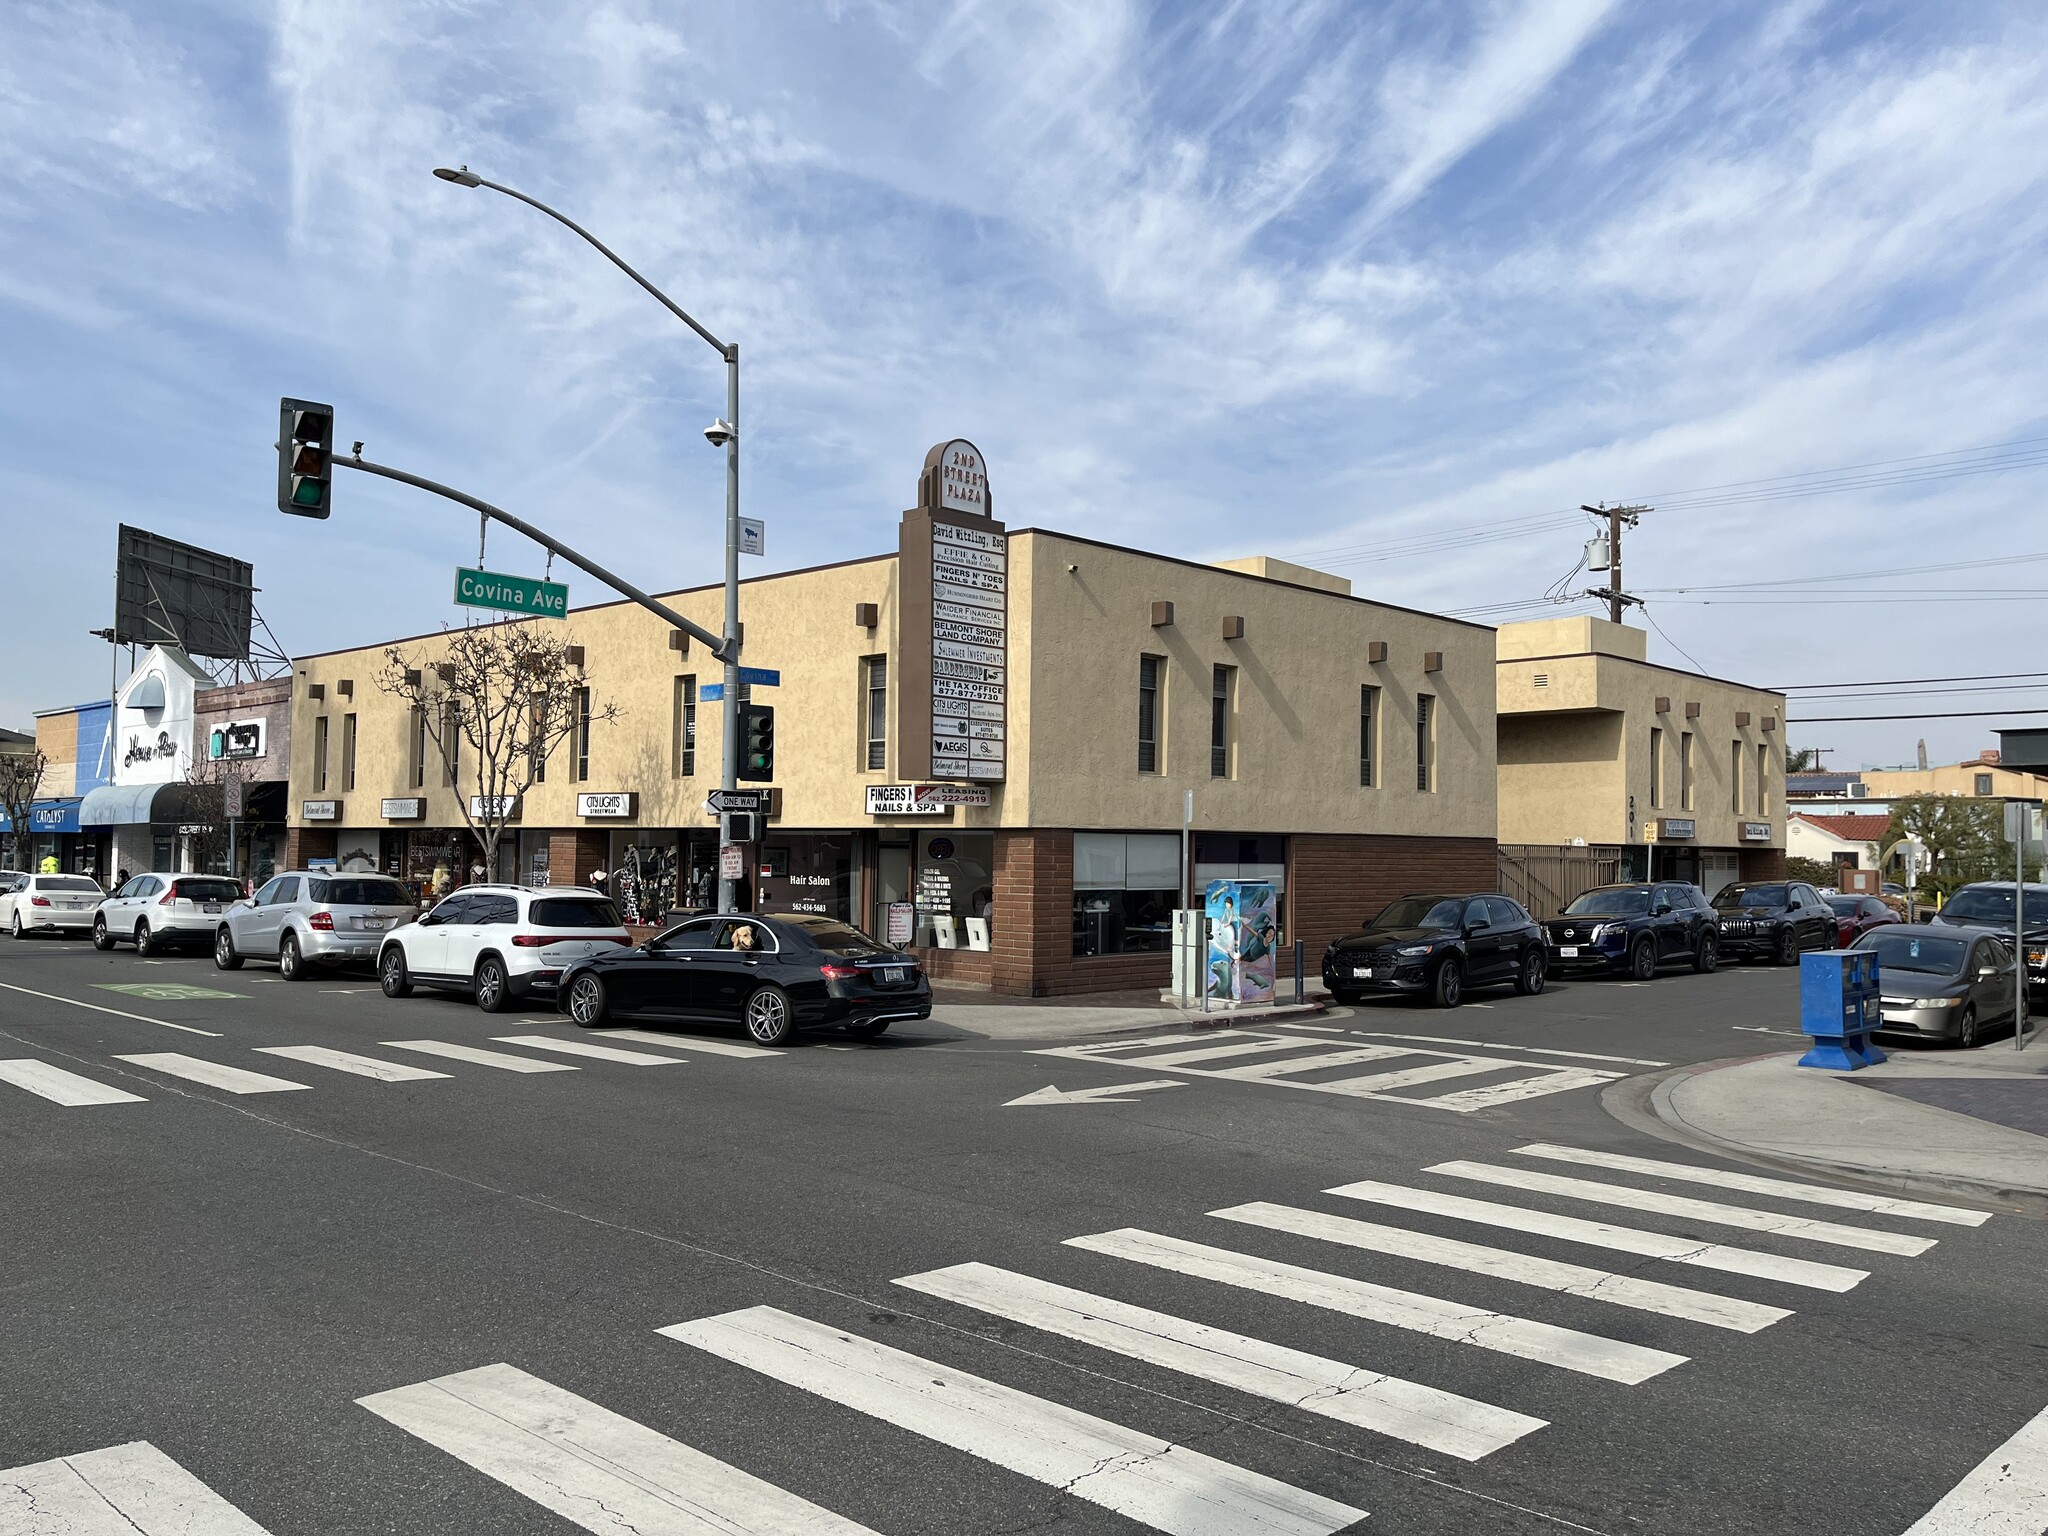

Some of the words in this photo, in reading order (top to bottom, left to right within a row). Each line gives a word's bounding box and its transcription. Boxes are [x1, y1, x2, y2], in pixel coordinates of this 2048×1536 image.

[953, 452, 975, 468] 2ND
[944, 465, 984, 487] STREET
[947, 484, 981, 504] PLAZA
[933, 524, 953, 539] David
[955, 528, 989, 548] Witzling,
[992, 536, 1004, 551] Esq
[944, 548, 968, 559] EFFIE
[972, 552, 977, 560] &
[937, 553, 965, 563] Precision
[966, 557, 978, 566] Hair
[979, 560, 999, 571] Cutting
[935, 565, 971, 578] FINGERS
[982, 573, 1003, 584] TOES
[941, 574, 969, 584] NAILS
[981, 582, 999, 590] SPA
[461, 577, 524, 604] Covina
[531, 589, 564, 610] Ave
[934, 621, 974, 634] BELMONT
[975, 627, 1003, 639] SHORE
[937, 629, 960, 639] LAND
[961, 633, 1000, 645] COMPANY
[933, 660, 983, 680] BARBERSHOP
[933, 679, 951, 687] THE
[953, 681, 970, 690] TAX
[972, 684, 1003, 695] OFFICE
[938, 687, 999, 701] 877-877-9730
[932, 698, 946, 709] CITY
[946, 701, 968, 712] LIGHTS
[942, 742, 968, 752] AEGIS
[933, 759, 953, 770] Belmont
[870, 787, 906, 801] FINGERS
[917, 788, 931, 799] NOW
[941, 794, 987, 803] 222-4919
[586, 796, 599, 808] CITY
[599, 796, 620, 808] LIGHTS
[723, 797, 739, 806] ONE
[741, 797, 756, 806] WAY
[875, 803, 903, 812] NAILS
[906, 803, 913, 812] &
[916, 803, 937, 812] SPA
[790, 875, 807, 885] Hair
[808, 875, 830, 886] Salon
